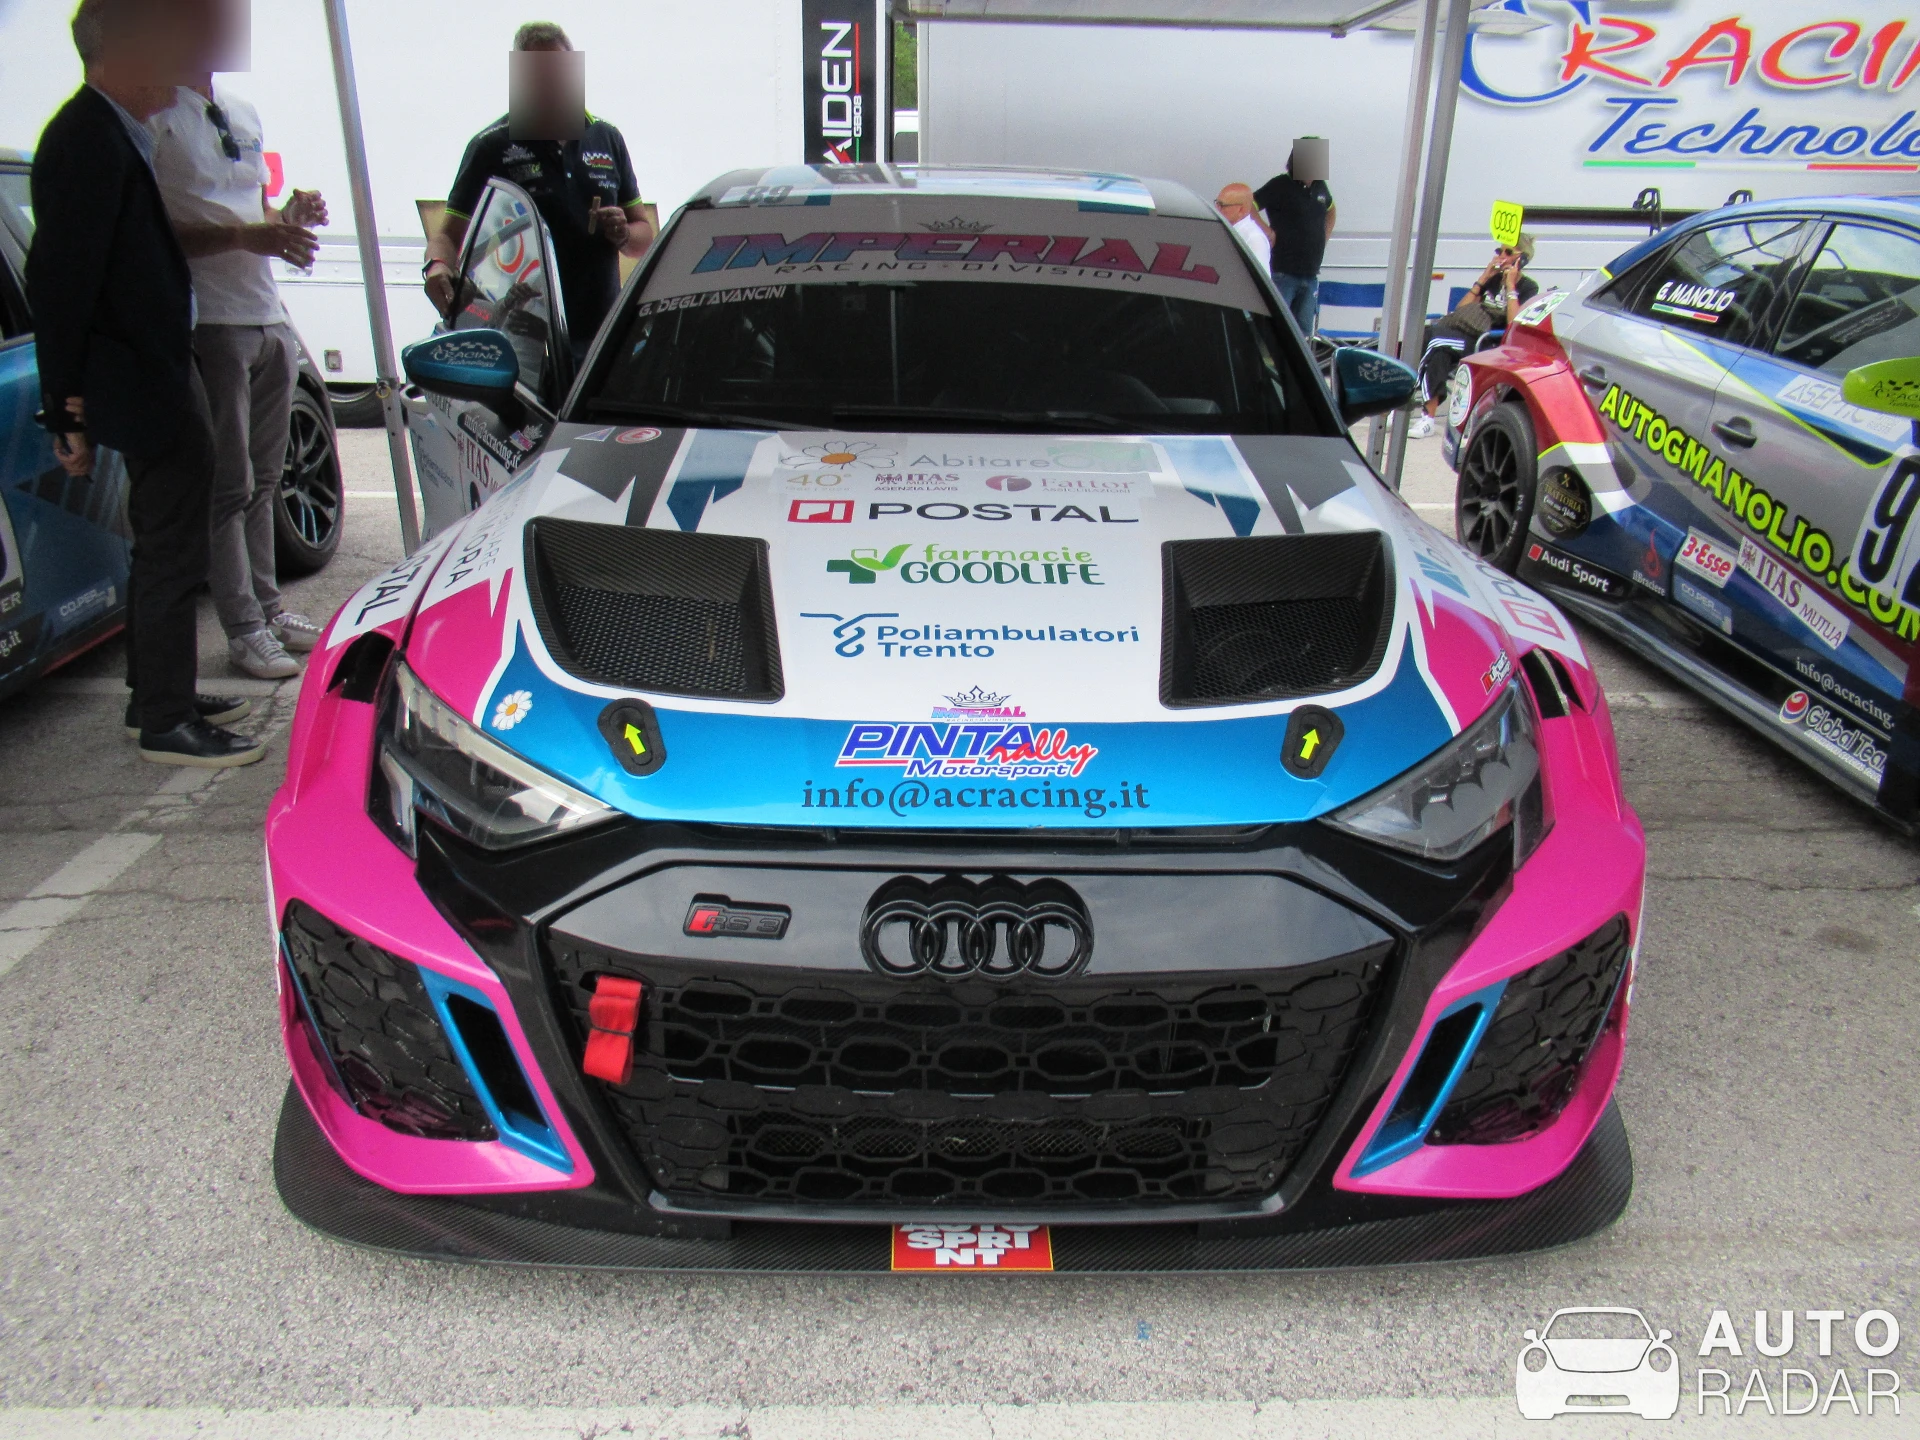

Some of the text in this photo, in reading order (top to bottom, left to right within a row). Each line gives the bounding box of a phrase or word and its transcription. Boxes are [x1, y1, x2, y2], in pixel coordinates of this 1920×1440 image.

[1560, 16, 1920, 88] RACI
[738, 185, 794, 204] 89
[691, 231, 1220, 285] IMPERIAL
[774, 260, 1143, 282] RACING DIVISION
[639, 285, 788, 317] G. DEGLI AVANCINI
[1667, 283, 1735, 312] MANOLIO
[466, 438, 491, 489] ITAS
[907, 473, 961, 481] ITAS
[868, 502, 1139, 523] POSTAL
[922, 543, 1093, 563] farmacie
[354, 538, 444, 626] OSTAL
[900, 560, 1106, 585] GOODLIFE
[1541, 550, 1610, 593] Audi Sport
[0, 590, 21, 613] ER
[1755, 553, 1844, 650] ITAS MUTUA
[877, 625, 1140, 642] Poliambulatori
[877, 641, 995, 658] Trento
[930, 705, 1027, 719] IMPERIAL
[838, 724, 1097, 776] PINTA rally
[1806, 704, 1860, 752] Global
[1853, 732, 1888, 774] Tea
[906, 758, 1069, 779] Motorsport
[801, 778, 1151, 819] info@acracing.it
[702, 914, 781, 933] RS 3
[906, 1231, 1030, 1249] SPRI
[935, 1248, 1005, 1265] NT
